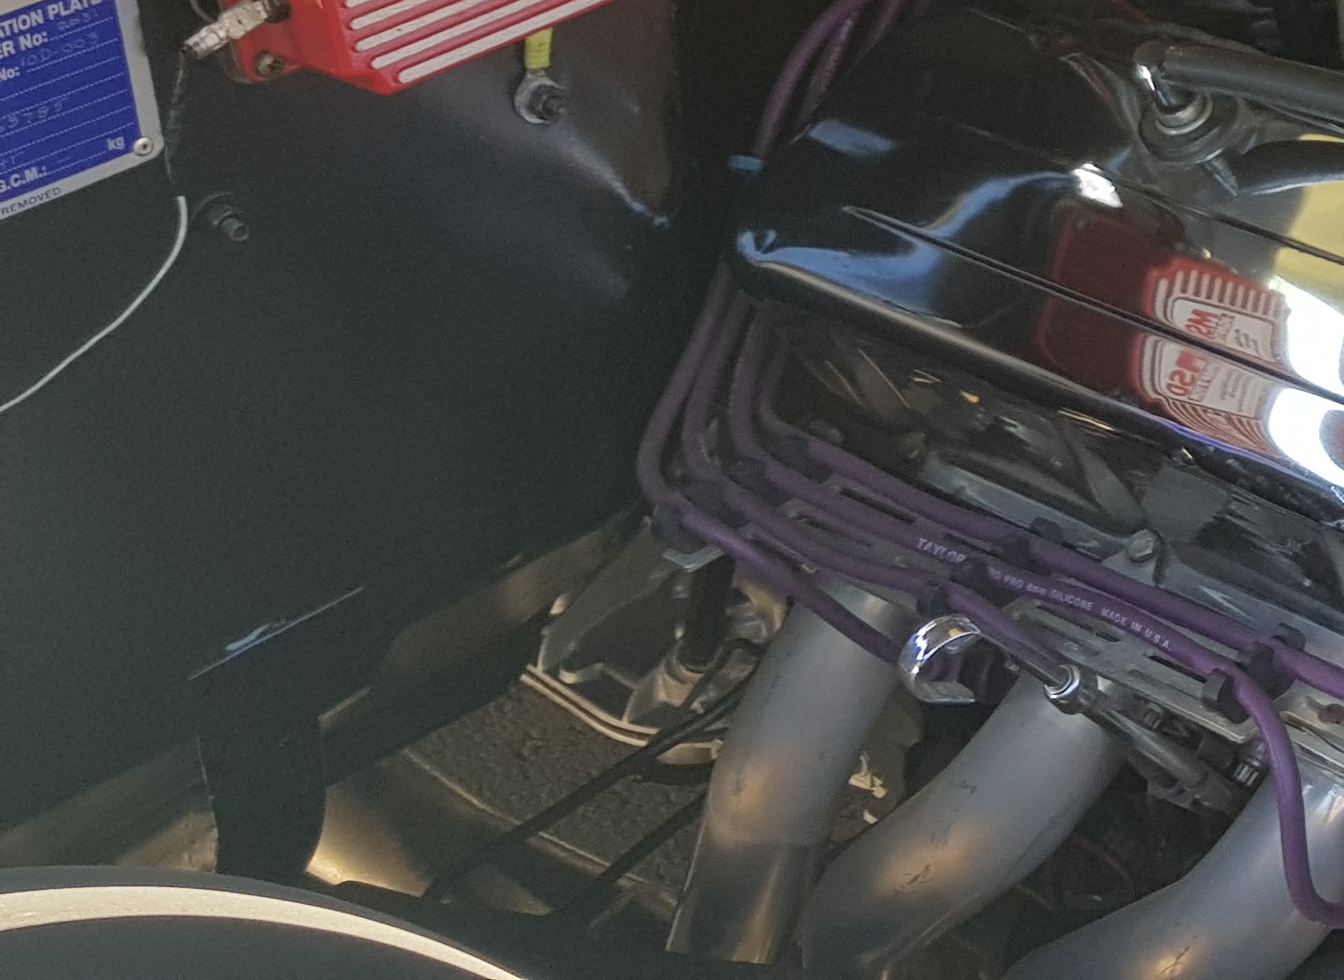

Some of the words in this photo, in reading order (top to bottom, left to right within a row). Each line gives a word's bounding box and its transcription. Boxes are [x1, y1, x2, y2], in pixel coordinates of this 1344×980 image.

[20, 31, 49, 50] No:
[107, 137, 125, 151] kg
[1, 187, 61, 215] REMOVED
[918, 537, 966, 563] TAYLOR
[1050, 588, 1094, 612] SILICONE
[1101, 606, 1127, 626] MADE
[1131, 621, 1142, 633] IN
